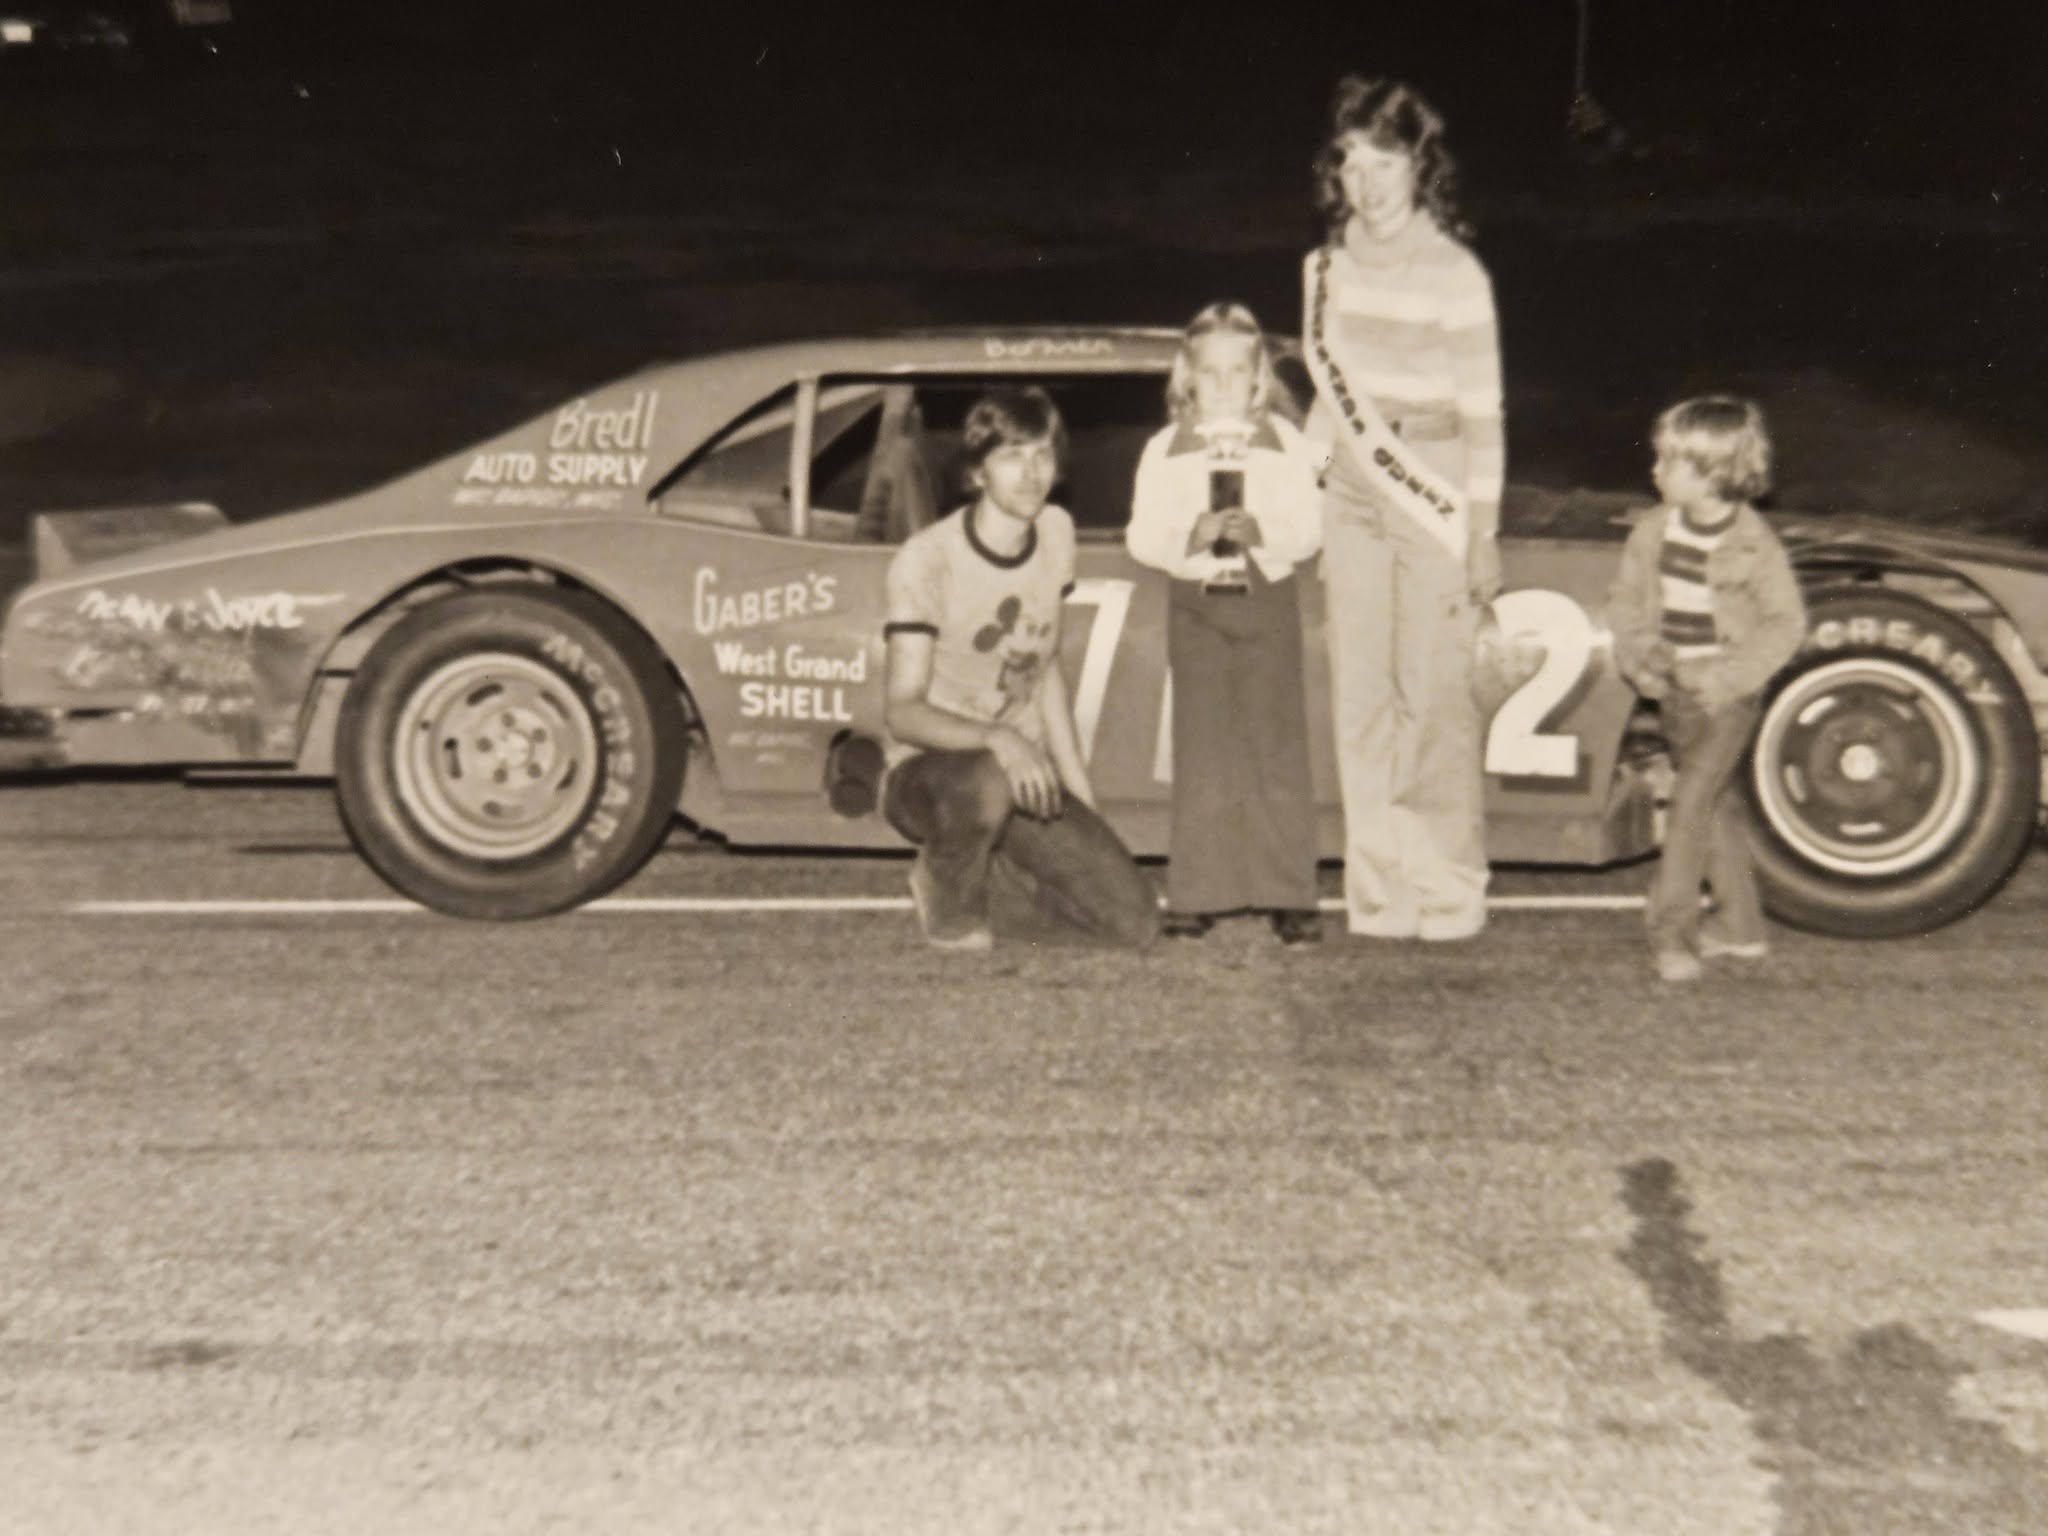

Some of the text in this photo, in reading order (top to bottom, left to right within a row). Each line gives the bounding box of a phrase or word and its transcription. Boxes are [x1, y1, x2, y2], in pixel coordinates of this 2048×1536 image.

[551, 391, 658, 449] Bredl
[464, 454, 648, 485] AUTO SUPPLY
[693, 566, 838, 635] GABER'S
[713, 642, 866, 683] West Grand
[1812, 617, 2005, 704] CREARY
[740, 682, 853, 722] SHELL
